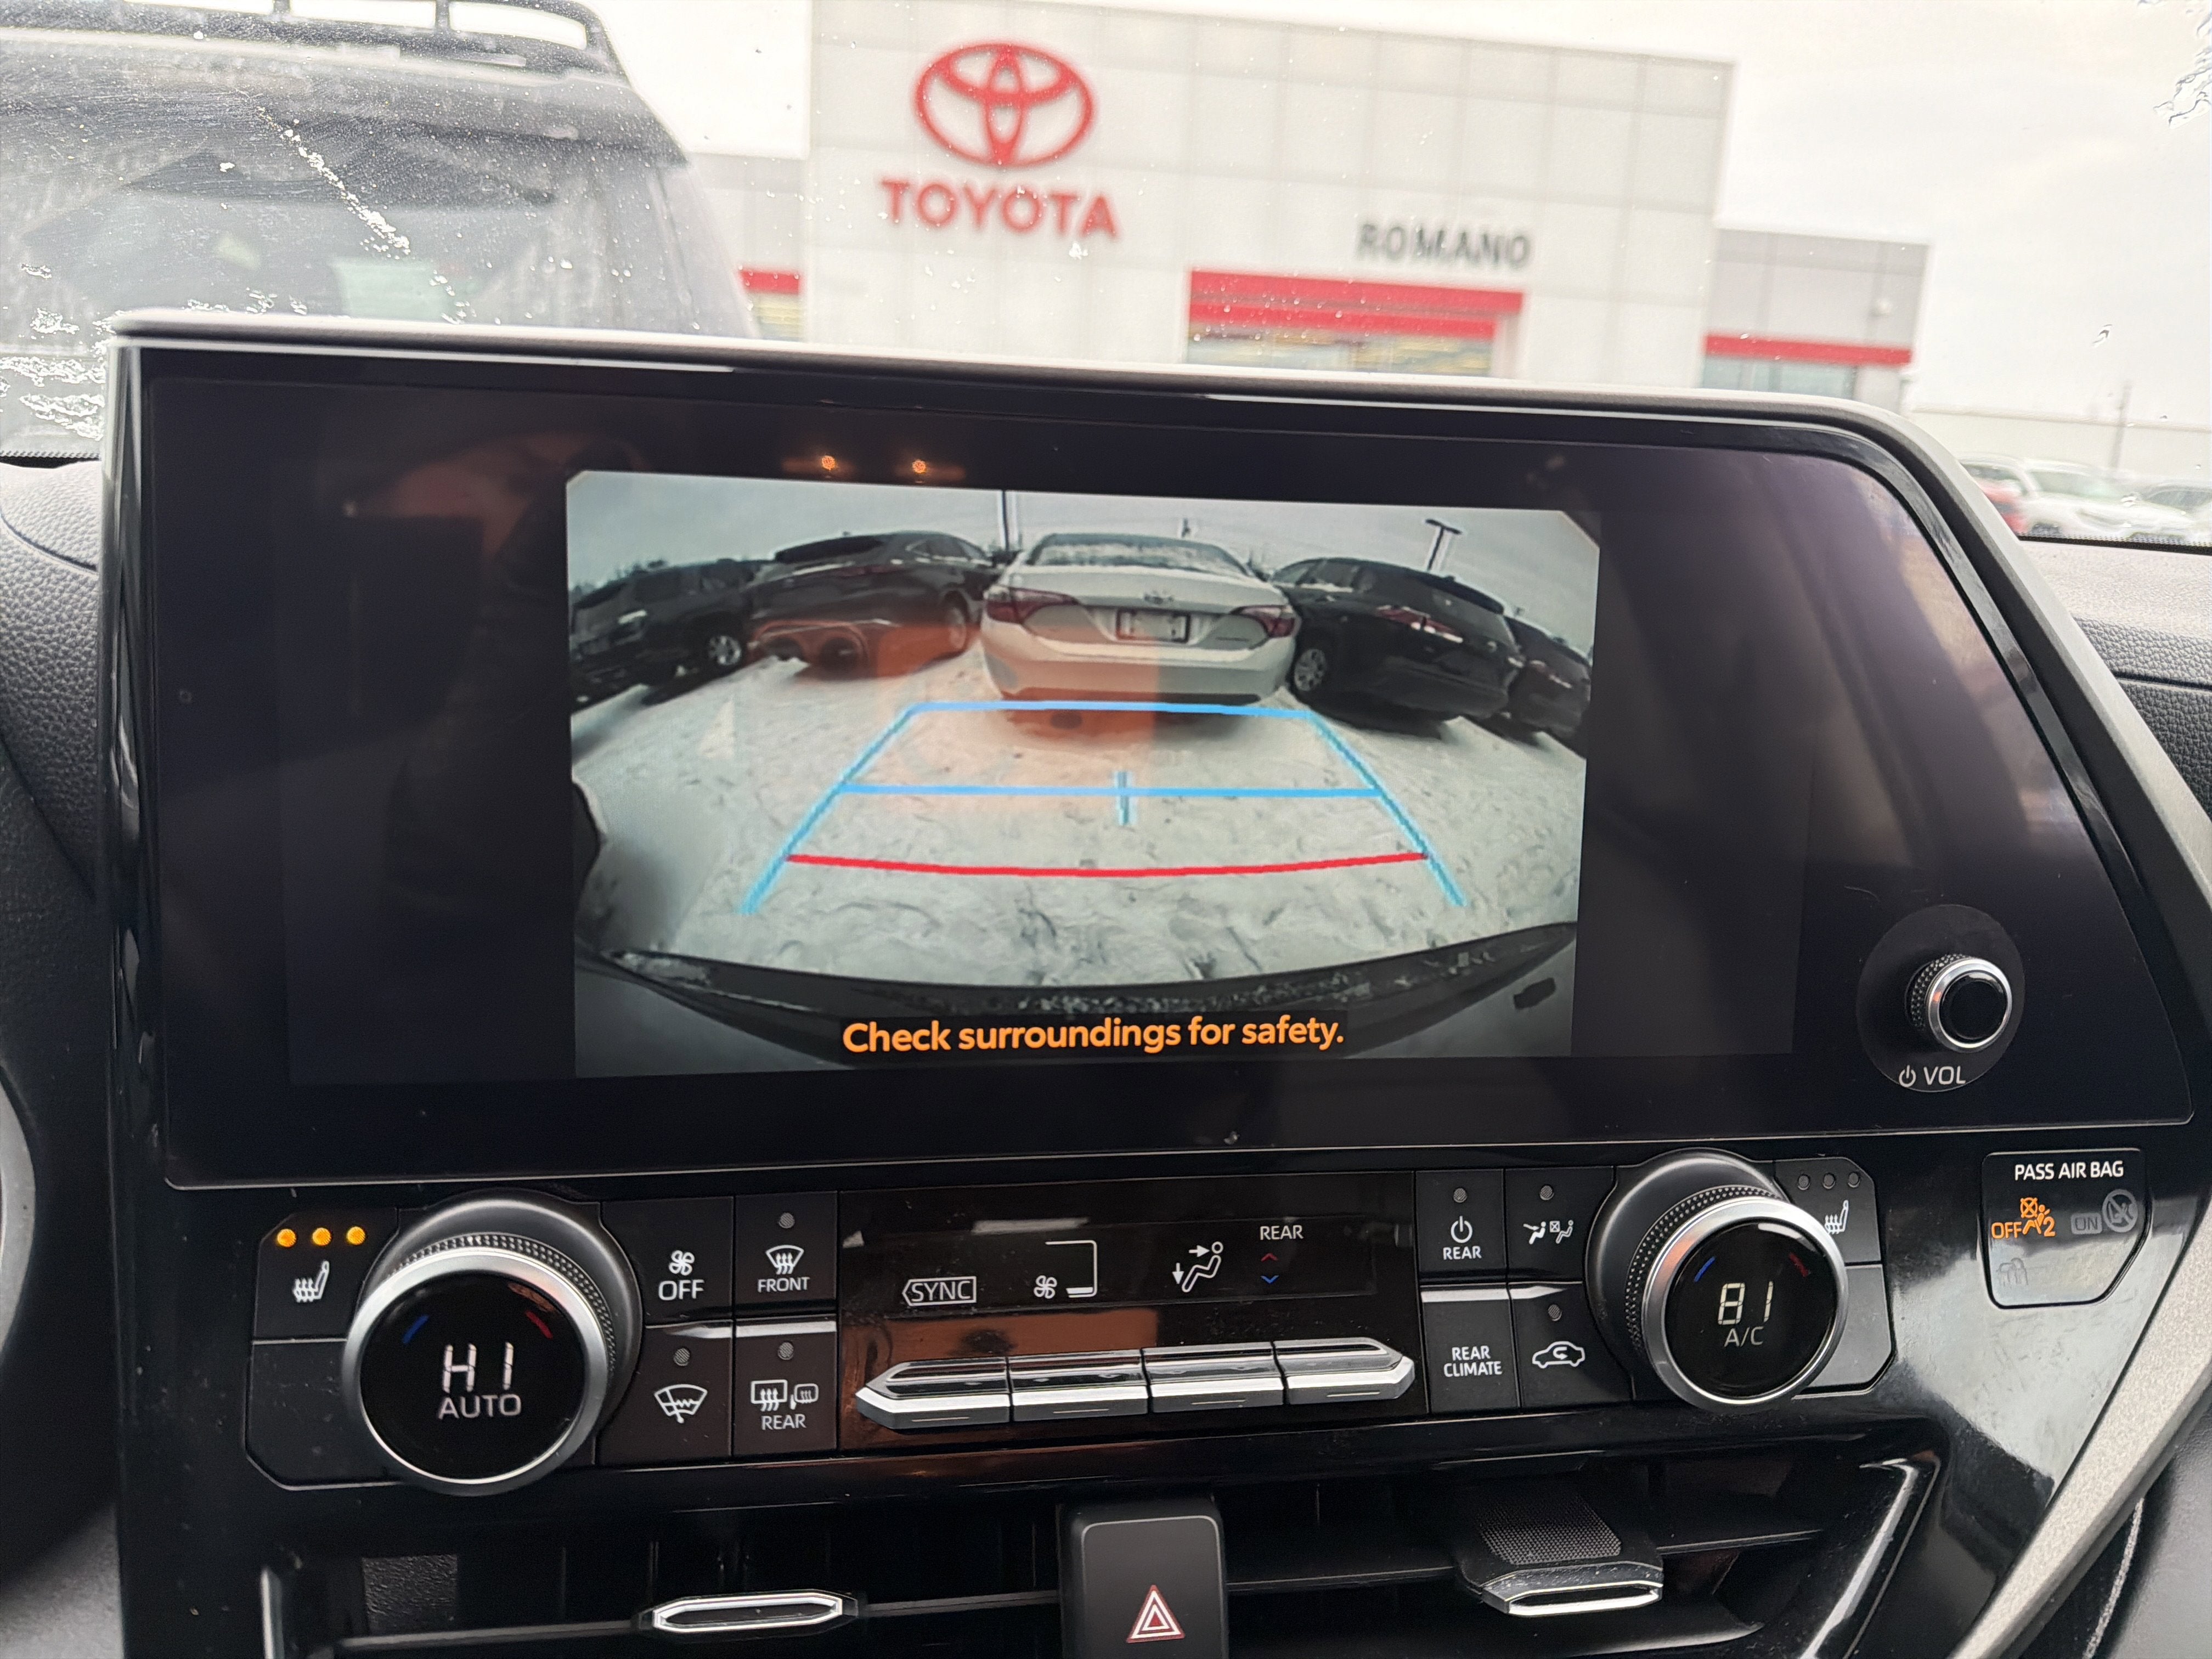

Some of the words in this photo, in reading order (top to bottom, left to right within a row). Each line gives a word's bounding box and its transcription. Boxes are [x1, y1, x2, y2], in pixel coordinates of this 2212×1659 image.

[879, 177, 1120, 240] TOYOTA
[1357, 221, 1532, 270] ROMANO
[843, 1020, 951, 1053] Check
[958, 1018, 1181, 1053] surroundings
[1188, 1015, 1236, 1046] for
[1242, 1014, 1344, 1051] safety.
[1923, 1065, 1966, 1085] VOL
[2015, 1163, 2055, 1181] PASS
[2058, 1162, 2087, 1180] AIR
[2090, 1160, 2124, 1178] BAG
[1260, 1224, 1304, 1240] REAR
[1991, 1221, 2023, 1239] OFF
[2075, 1217, 2098, 1231] ON
[1443, 1245, 1482, 1261] REAR
[658, 1279, 704, 1301] OFF
[757, 1276, 810, 1293] FRONT
[910, 1280, 971, 1302] SYNC
[1718, 1281, 1774, 1325] 81
[1724, 1326, 1764, 1347] A/C
[1451, 1345, 1491, 1362] REAR
[1443, 1361, 1503, 1378] CLIMATE
[439, 1393, 521, 1419] AUTO
[761, 1413, 806, 1430] REAR
